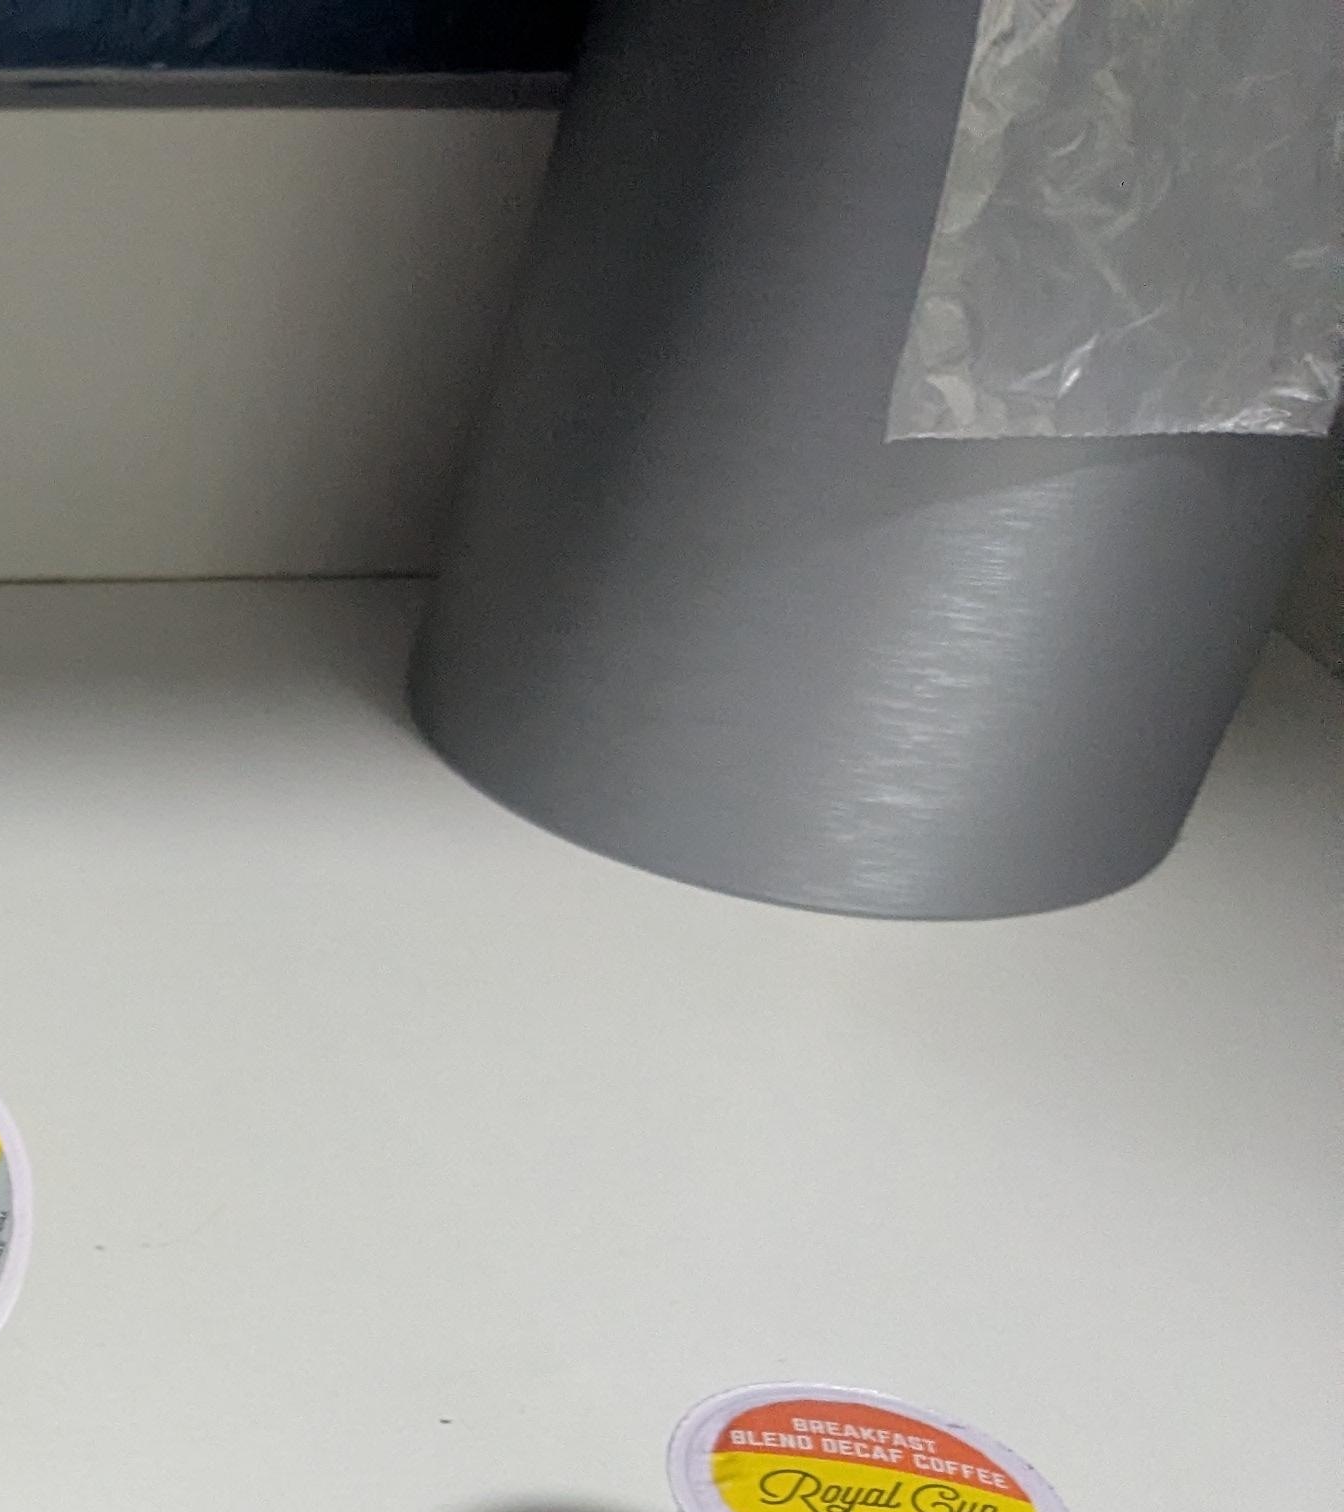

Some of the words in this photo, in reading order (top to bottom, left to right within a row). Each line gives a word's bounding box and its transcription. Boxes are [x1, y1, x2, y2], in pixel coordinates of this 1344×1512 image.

[728, 1428, 814, 1450] BLEND
[820, 1435, 903, 1466] DECAF
[914, 1453, 1010, 1490] COFFEE
[791, 1417, 937, 1454] BREAKFAST
